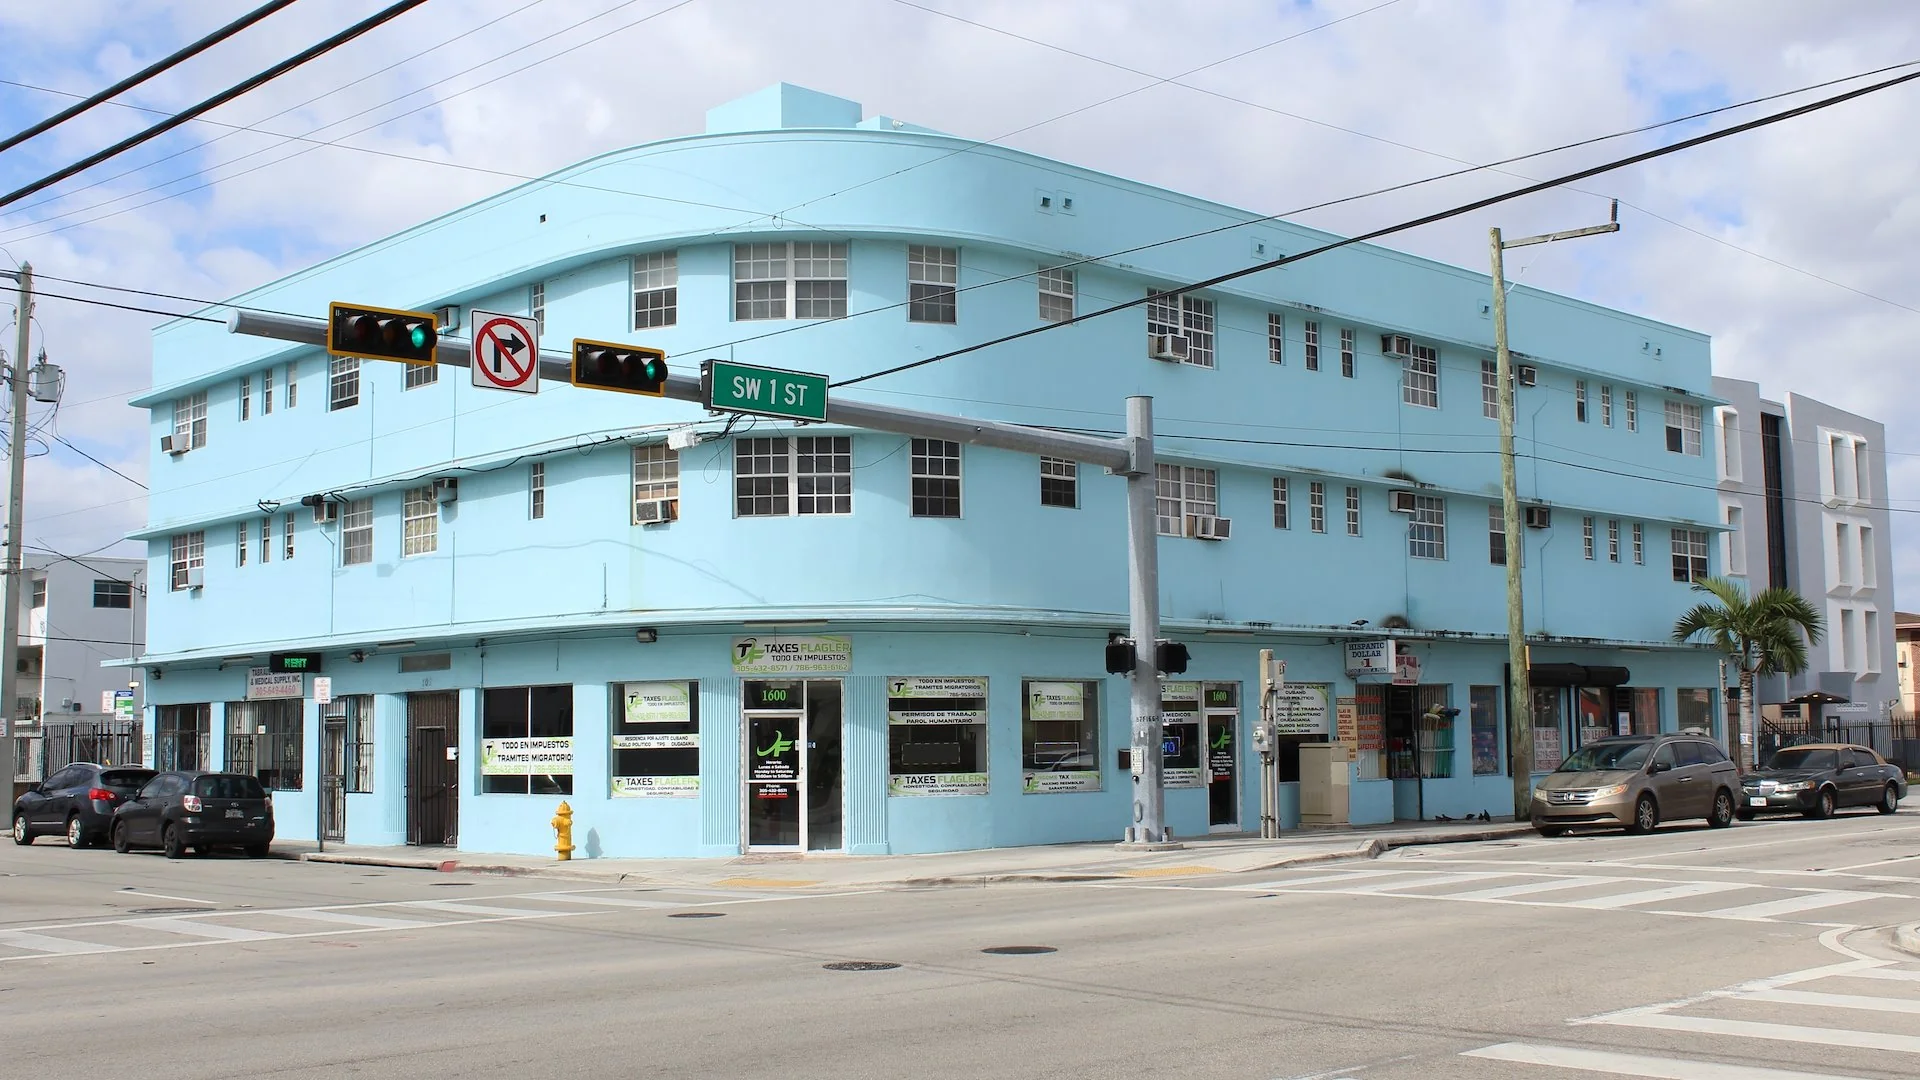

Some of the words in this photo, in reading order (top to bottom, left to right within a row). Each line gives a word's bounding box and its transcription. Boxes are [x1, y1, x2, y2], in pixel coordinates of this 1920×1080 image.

[732, 375, 762, 401] SW
[769, 379, 777, 405] 1
[783, 383, 808, 406] ST
[764, 643, 799, 653] TAXES
[800, 643, 850, 654] FLAGLER
[1349, 642, 1385, 651] HISPANIC
[772, 654, 791, 662] TODO
[792, 654, 803, 662] EN
[804, 653, 846, 661] IMPUESTOS
[255, 677, 273, 686] MEDICAL
[762, 689, 787, 702] 1600
[1213, 691, 1227, 702] 1600
[502, 741, 519, 749] TODO
[520, 741, 529, 749] EN
[530, 740, 569, 749] IMPUESTOS
[498, 754, 529, 762] TRAMITES
[626, 777, 653, 786] TAXES
[905, 775, 936, 784] TAXES
[937, 775, 980, 784] FLAGLER
